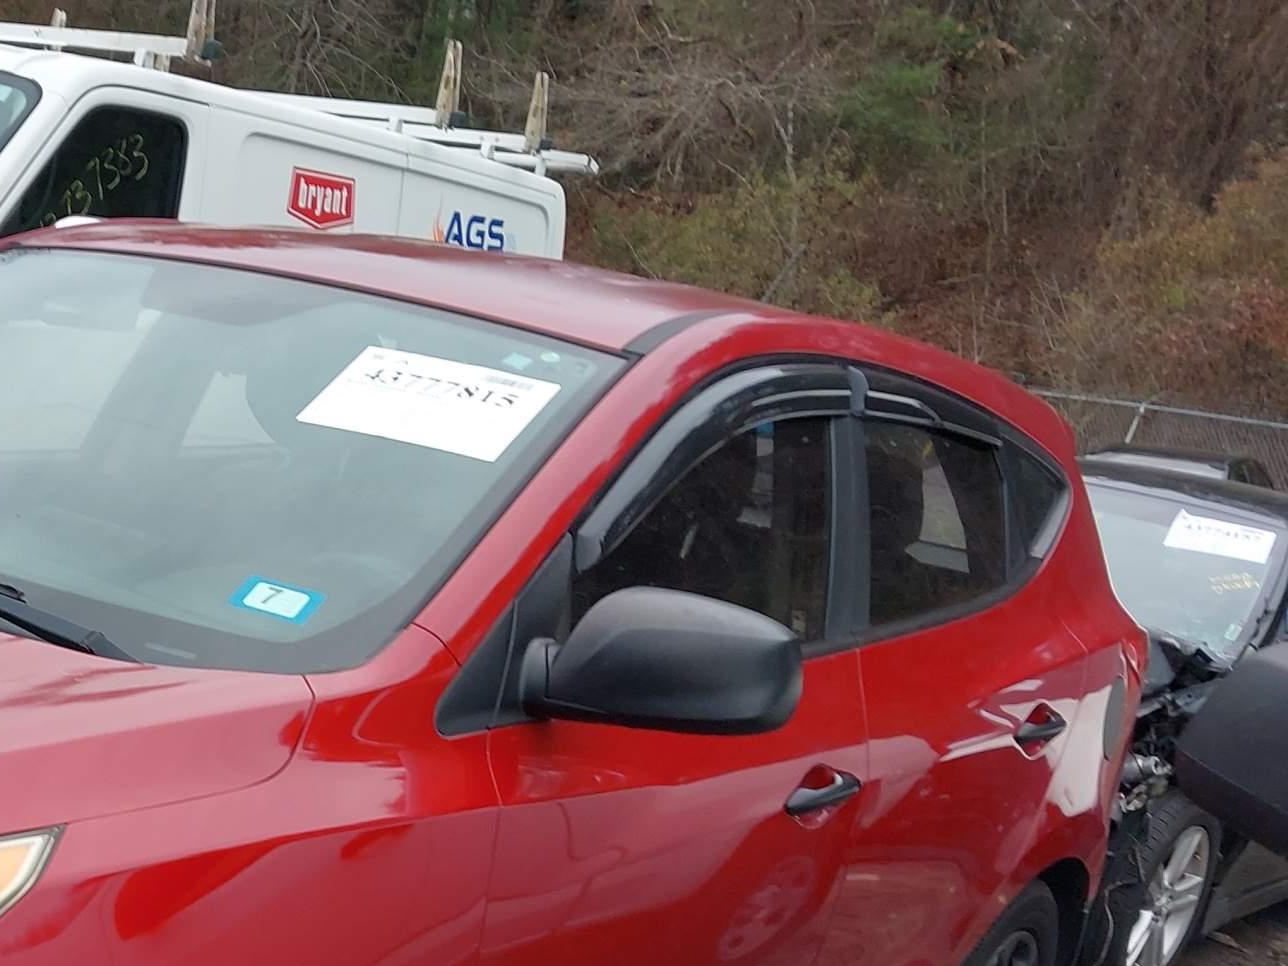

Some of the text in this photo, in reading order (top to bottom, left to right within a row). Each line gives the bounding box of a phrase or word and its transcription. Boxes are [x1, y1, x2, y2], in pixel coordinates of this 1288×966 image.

[298, 176, 349, 217] bryant
[444, 210, 505, 251] AGS
[365, 369, 519, 407] 43777815
[260, 587, 284, 605] 7
